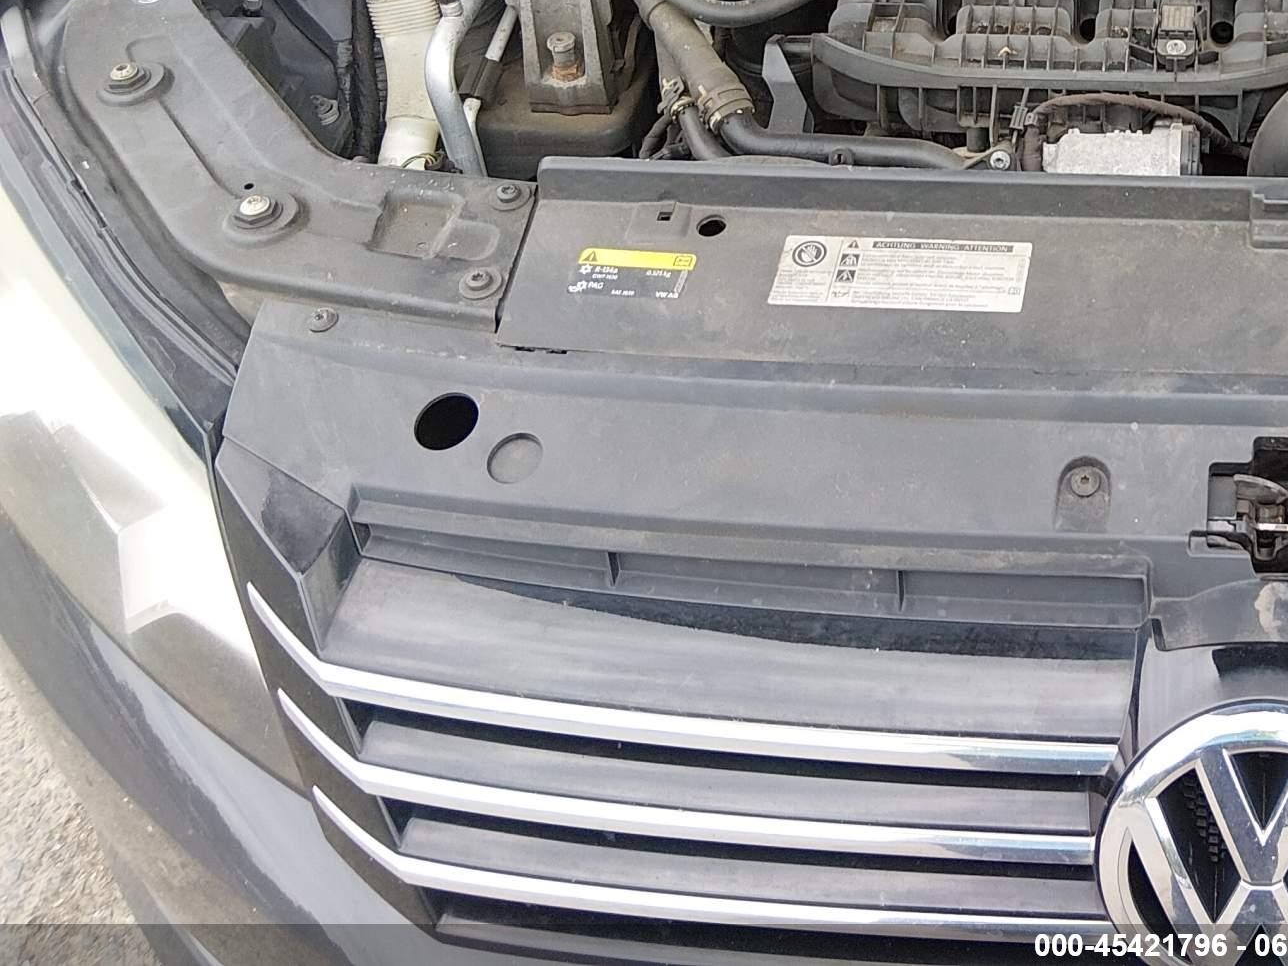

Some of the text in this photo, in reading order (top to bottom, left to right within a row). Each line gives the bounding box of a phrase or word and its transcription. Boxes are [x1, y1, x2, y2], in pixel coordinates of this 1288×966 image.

[876, 241, 1009, 253] ACHTUNG WARNING ATTENTION
[587, 280, 604, 290] PAG
